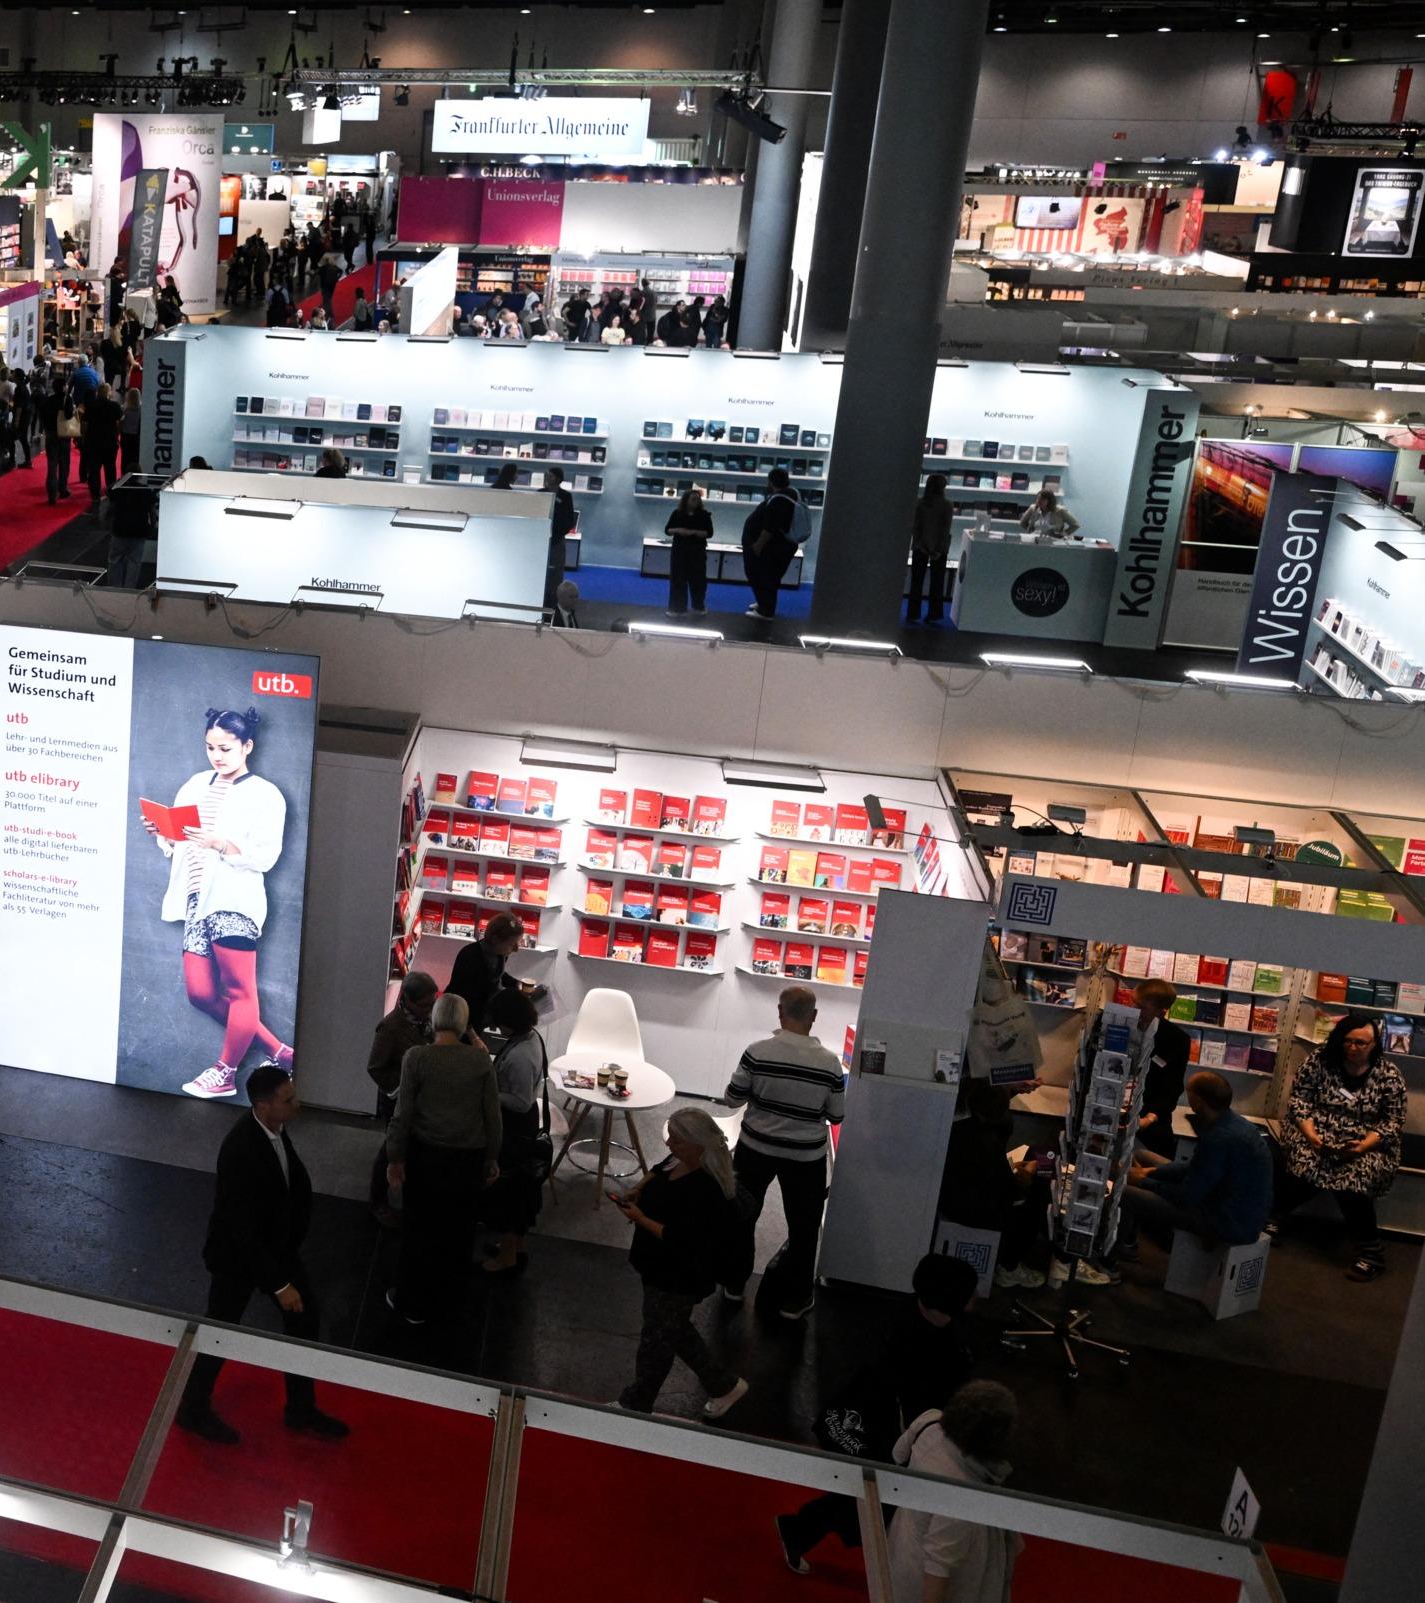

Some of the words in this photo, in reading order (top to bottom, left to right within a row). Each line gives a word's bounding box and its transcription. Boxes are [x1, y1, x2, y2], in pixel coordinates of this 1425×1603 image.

[149, 126, 185, 135] Franziska
[187, 125, 216, 135] Gänsler
[450, 114, 539, 134] Frankfurter
[541, 116, 629, 140] Allgemeine
[182, 140, 215, 155] Orca
[480, 167, 541, 179] C.H.BECK
[487, 187, 560, 206] Unionsverlag
[137, 204, 157, 285] KATAPULT
[268, 372, 310, 381] Kohlhammer
[490, 384, 534, 393] Kohlhammer
[728, 397, 775, 407] Kohlhammer
[984, 410, 1035, 421] Kohlhammer
[1117, 405, 1186, 617] Kohlhammer
[311, 576, 382, 592] Kohlhammer
[1249, 507, 1324, 663] Wissen
[1015, 586, 1057, 606] sexy!
[9, 646, 87, 665] Gemeinsam
[9, 664, 28, 677] für
[31, 667, 87, 683] Studium
[91, 675, 116, 687] und
[258, 674, 299, 695] utb.
[8, 682, 95, 702] Wissenschaft
[7, 712, 29, 724] utb
[6, 732, 28, 741] Lehr-
[29, 735, 47, 744] und
[49, 737, 100, 750] Lernmedien
[102, 745, 118, 753] aus
[6, 744, 25, 753] über
[28, 748, 39, 756] 30
[41, 748, 103, 763] Fachbereichen
[5, 770, 27, 782] utb
[30, 772, 80, 792] elibrary
[4, 800, 46, 813] Plattform
[5, 791, 35, 800] 30.000
[38, 793, 57, 803] Titel
[59, 797, 73, 805] auf
[76, 800, 98, 808] einer
[4, 824, 77, 840] utb-studi-e-book
[4, 836, 19, 844] alle
[21, 838, 48, 848] digital
[51, 842, 98, 854] lieferbaren
[1307, 843, 1339, 860] Jubiläum
[3, 847, 69, 862] utb-Lehrbücher
[3, 869, 78, 887] scholars-e-library
[3, 881, 79, 898] wissenschaftliche
[2, 891, 57, 906] Fachliteratur
[77, 903, 100, 912] mehr
[17, 906, 26, 914] 55
[29, 907, 67, 919] Verlagen
[1236, 1490, 1248, 1525] A
